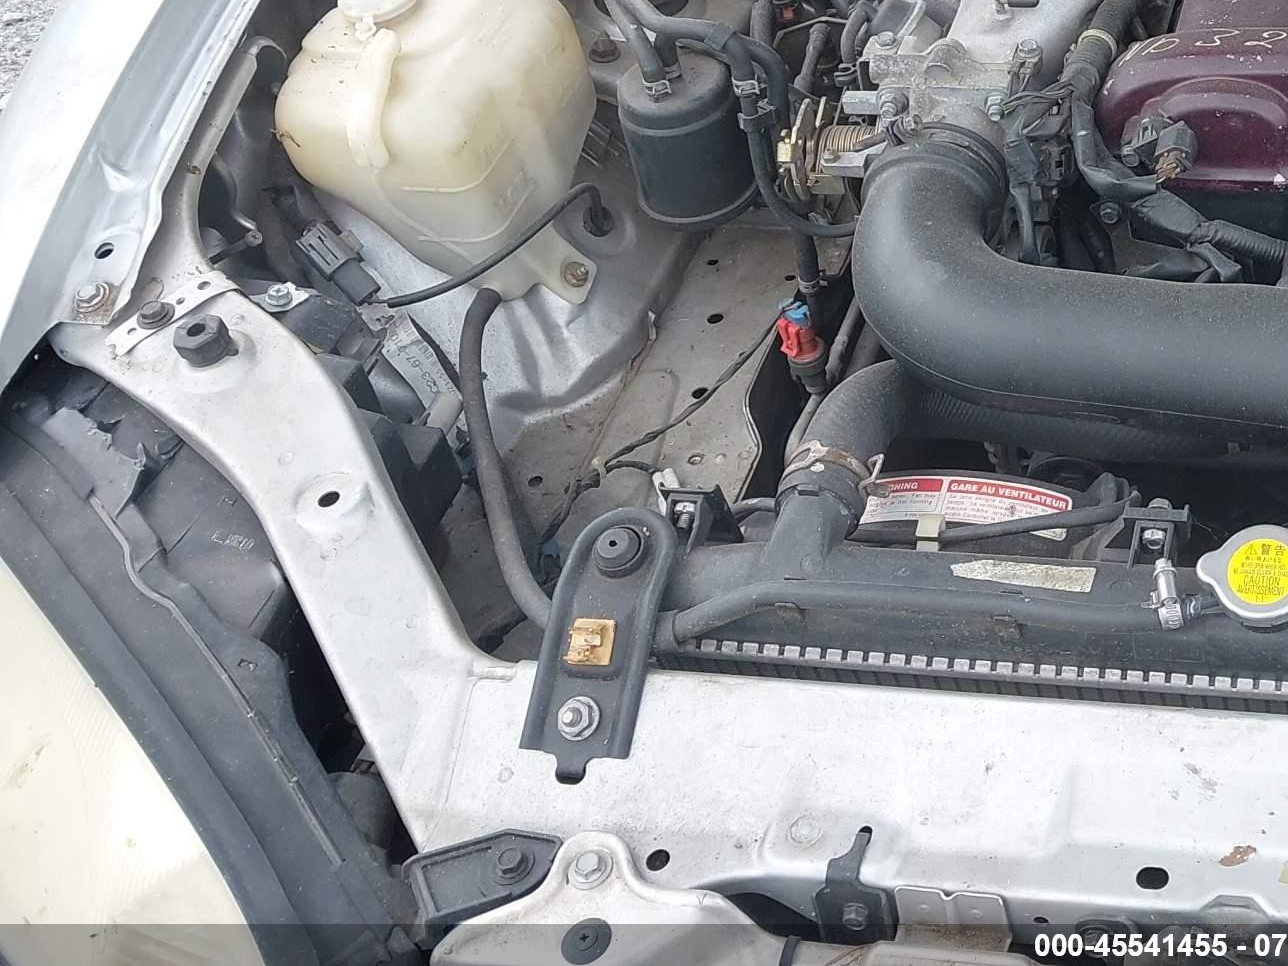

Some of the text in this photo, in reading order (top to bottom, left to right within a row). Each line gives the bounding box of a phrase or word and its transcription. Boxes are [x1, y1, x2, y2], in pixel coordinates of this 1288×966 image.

[950, 482, 979, 492] GARE
[980, 485, 996, 494] AU
[998, 487, 1067, 509] VENTILATEUR
[1243, 575, 1280, 586] CAUTION
[1237, 584, 1285, 596] AVERTISSEMENT
